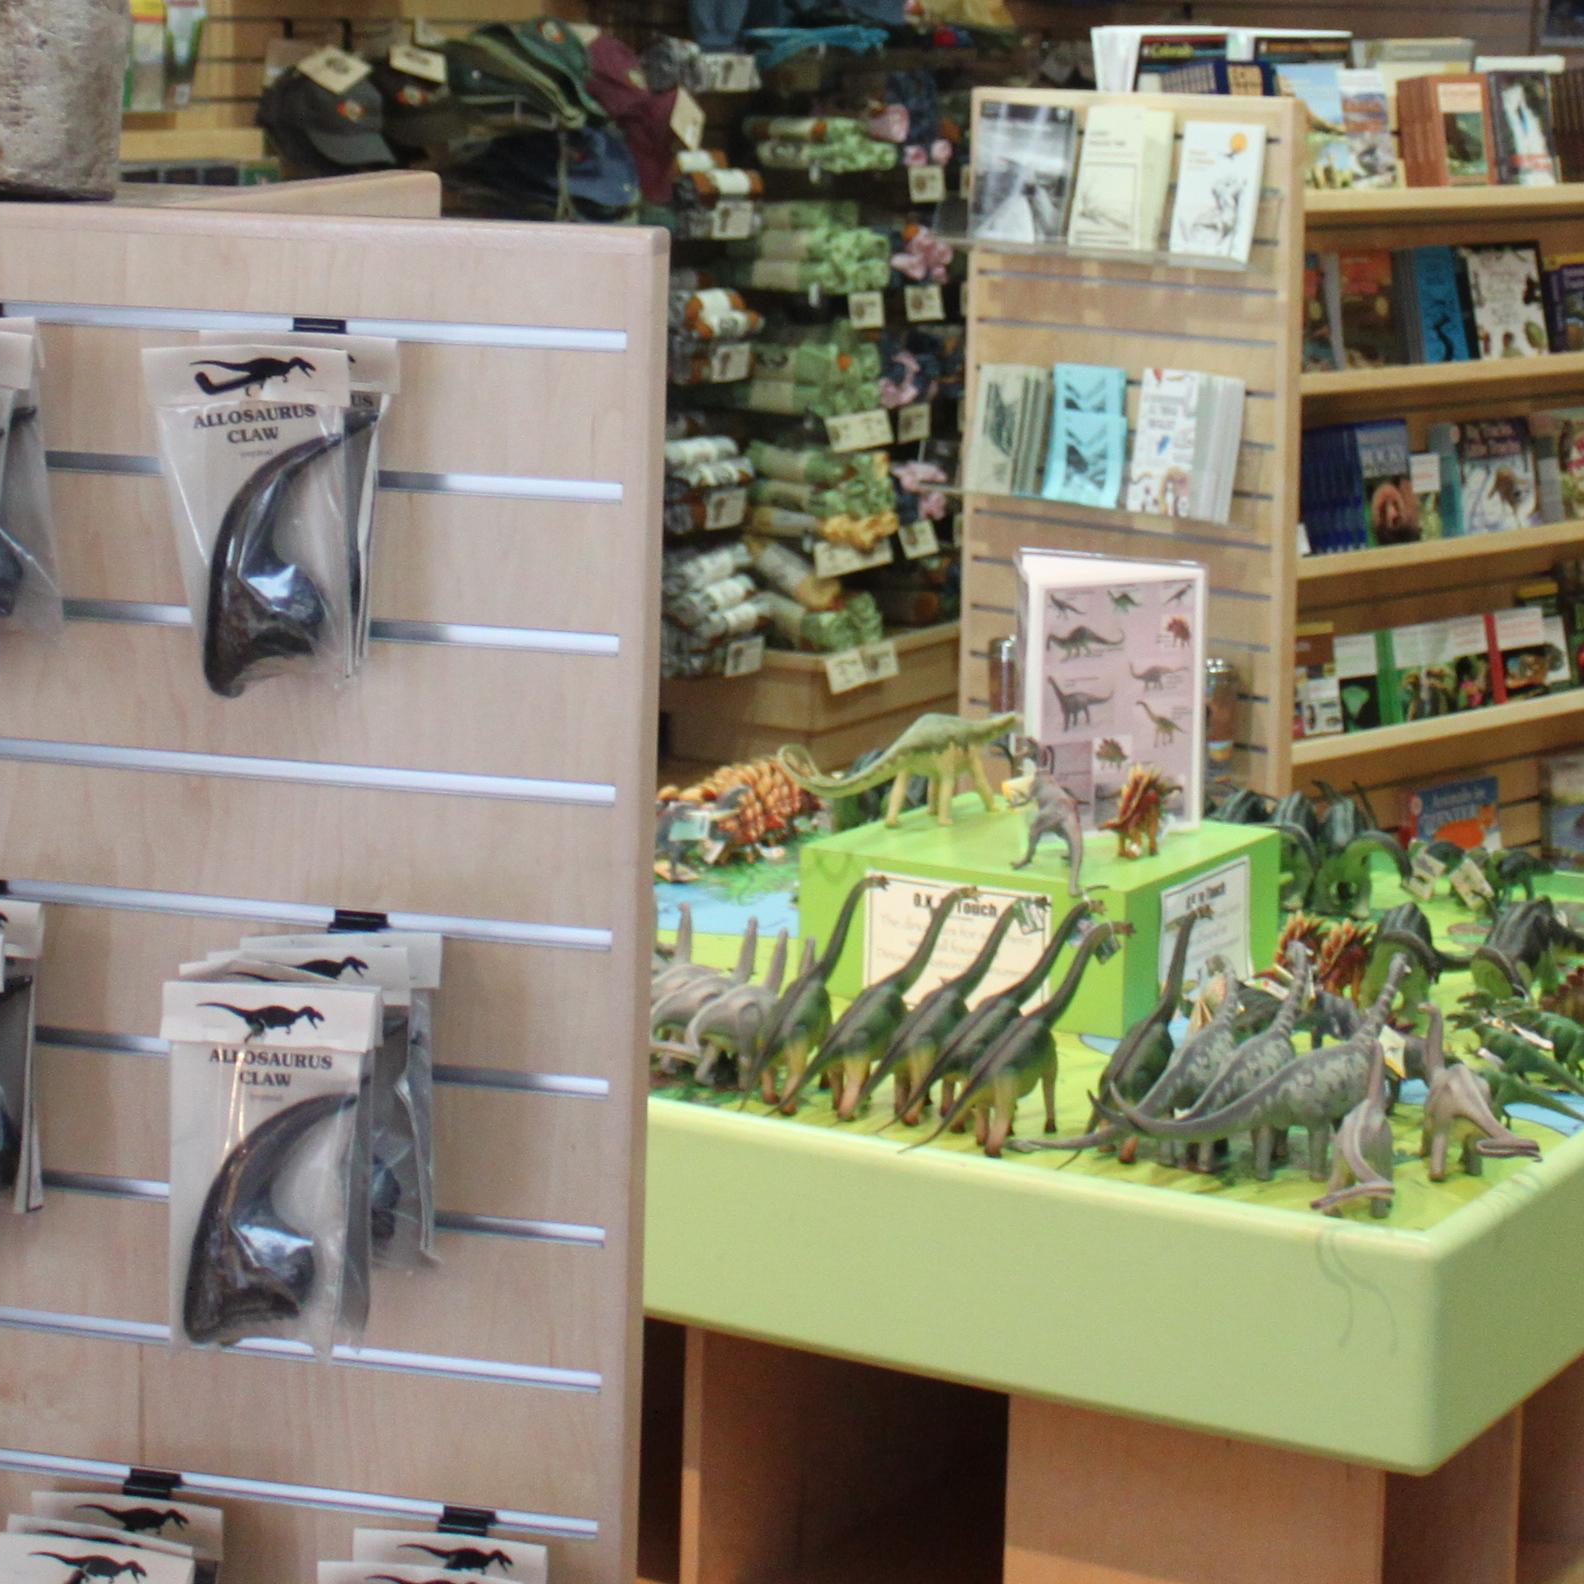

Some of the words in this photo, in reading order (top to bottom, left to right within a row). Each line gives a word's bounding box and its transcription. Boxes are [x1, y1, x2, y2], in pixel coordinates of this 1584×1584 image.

[194, 403, 317, 429] ALLOSAURUS
[227, 426, 279, 444] CLAW
[209, 1048, 334, 1071] ALLOSAURUS
[239, 1070, 292, 1087] CLAW
